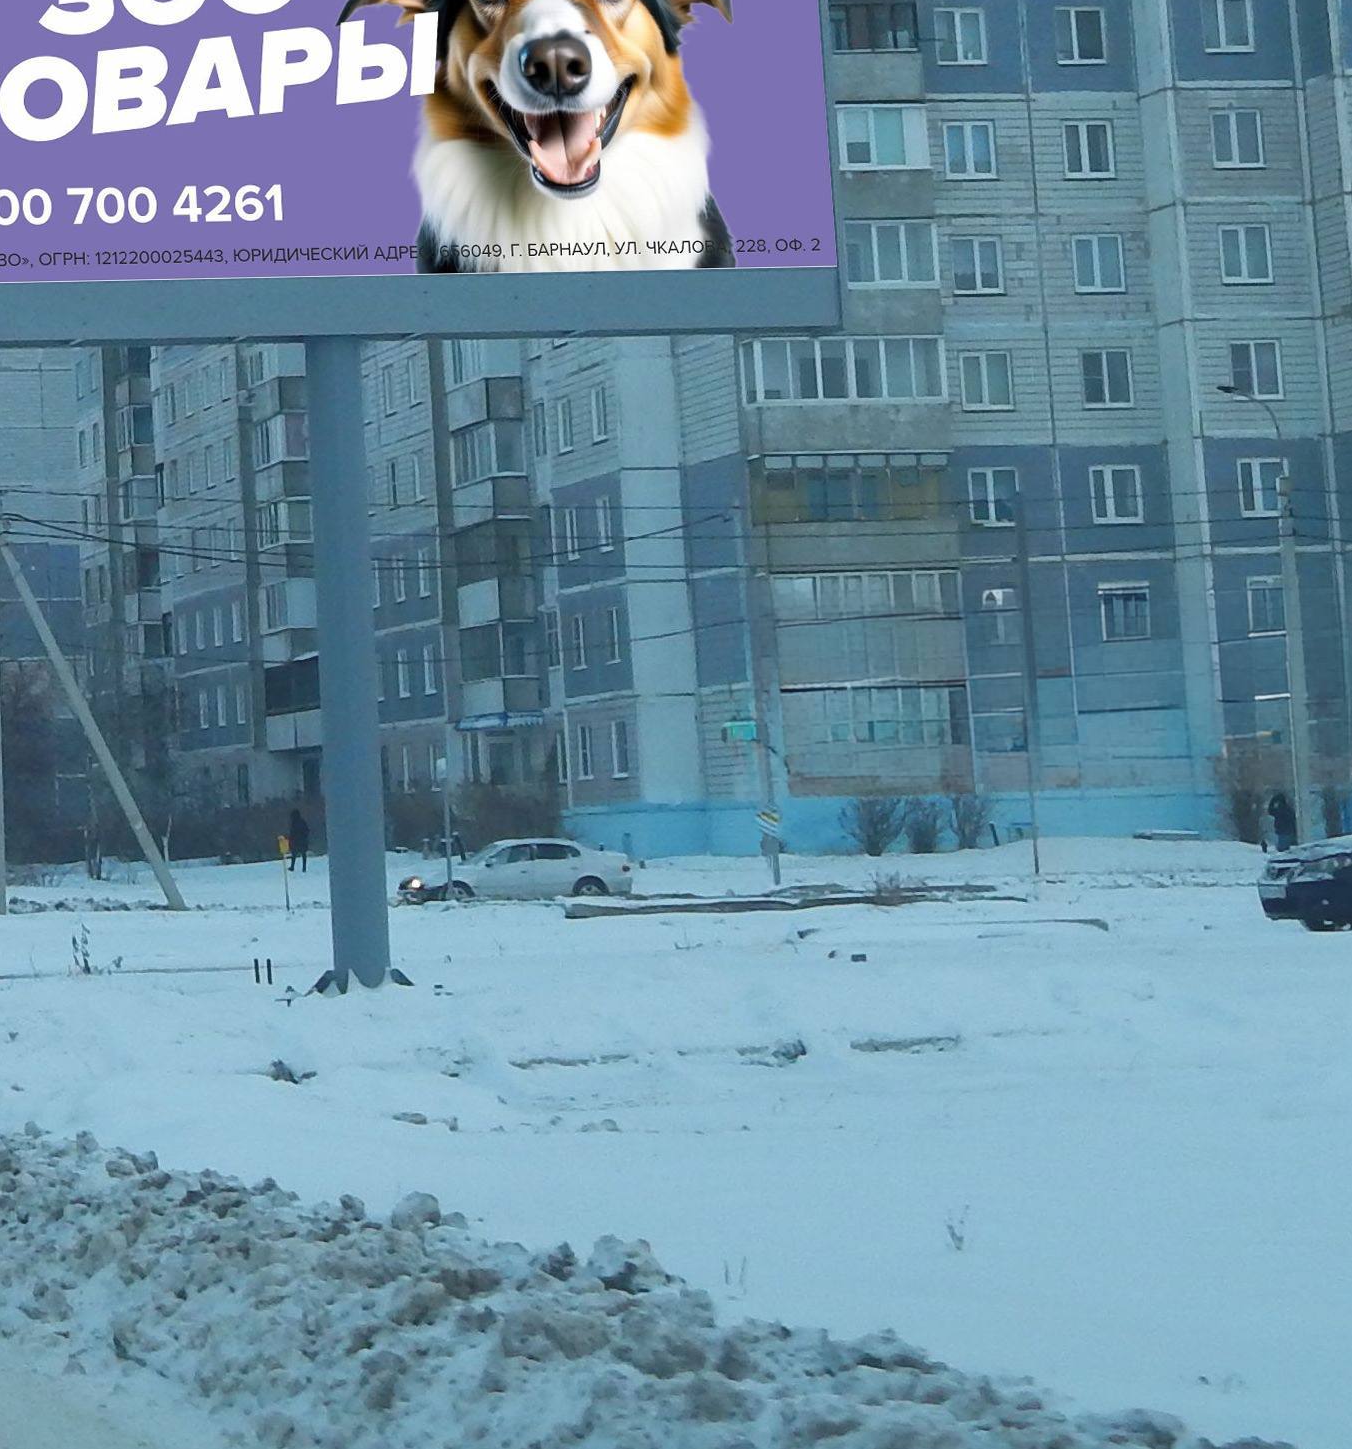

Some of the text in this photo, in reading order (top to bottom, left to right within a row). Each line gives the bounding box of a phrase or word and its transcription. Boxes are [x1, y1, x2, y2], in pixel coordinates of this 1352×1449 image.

[66, 186, 158, 225] 700
[172, 183, 285, 223] 4261
[38, 251, 91, 267] ОГРН:
[95, 249, 229, 266] 1212200025443,
[233, 244, 369, 264] ЮРИДИЧЕСКИЙ
[439, 243, 506, 260] 656049,
[510, 243, 523, 258] Г.
[527, 241, 610, 258] БАРНАУЛ,
[614, 241, 642, 256] УЛ.
[736, 239, 771, 254] 228,
[775, 238, 806, 253] ОФ.
[810, 238, 822, 252] 2
